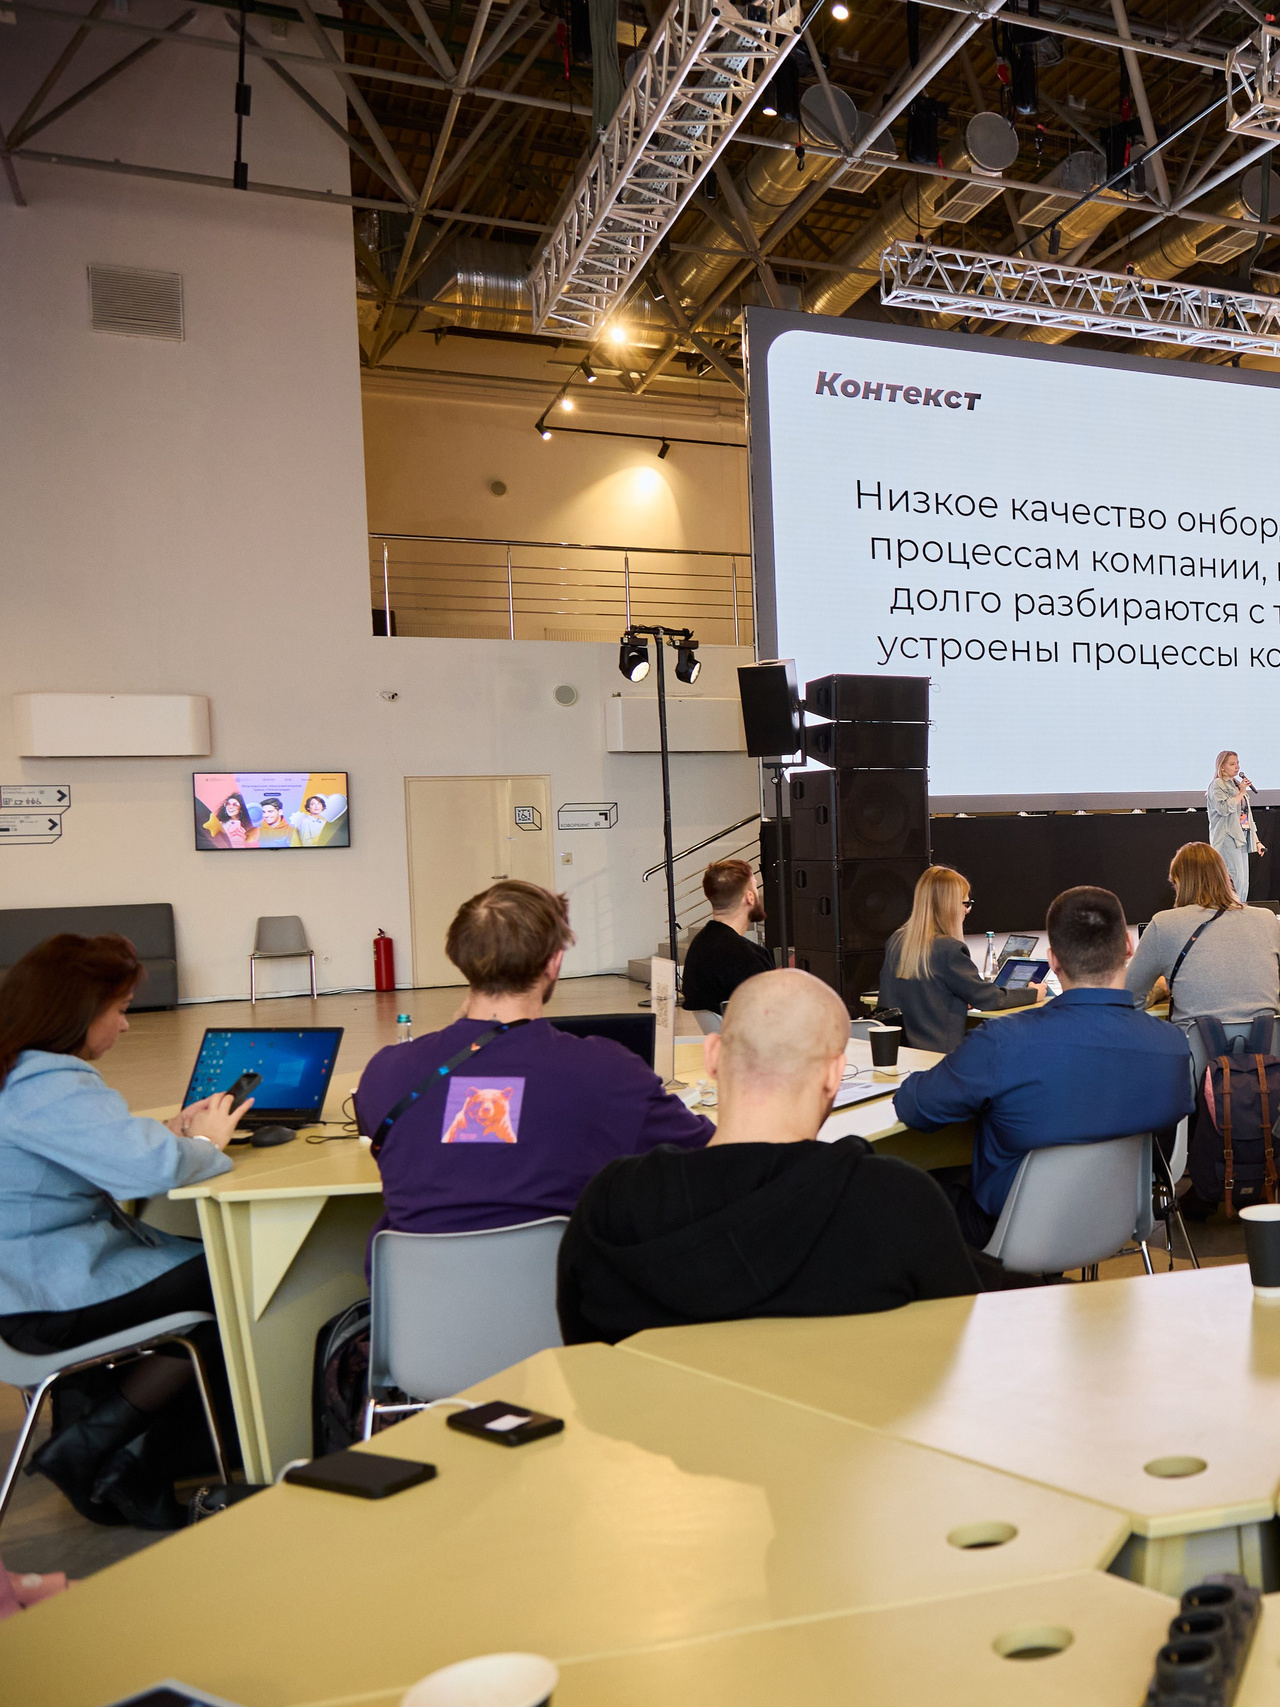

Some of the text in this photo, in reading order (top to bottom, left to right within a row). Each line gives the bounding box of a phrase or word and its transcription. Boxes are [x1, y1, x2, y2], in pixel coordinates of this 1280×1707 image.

[815, 370, 982, 411] Контекст
[856, 479, 999, 519] Низкое
[1011, 498, 1167, 531] качество
[870, 536, 1079, 571] процессам
[1092, 550, 1267, 586] компании,
[889, 587, 1002, 616] долго
[1014, 587, 1238, 626] разбираются
[1249, 604, 1265, 624] с
[876, 635, 1059, 668] устроены
[1072, 641, 1238, 671] процессы
